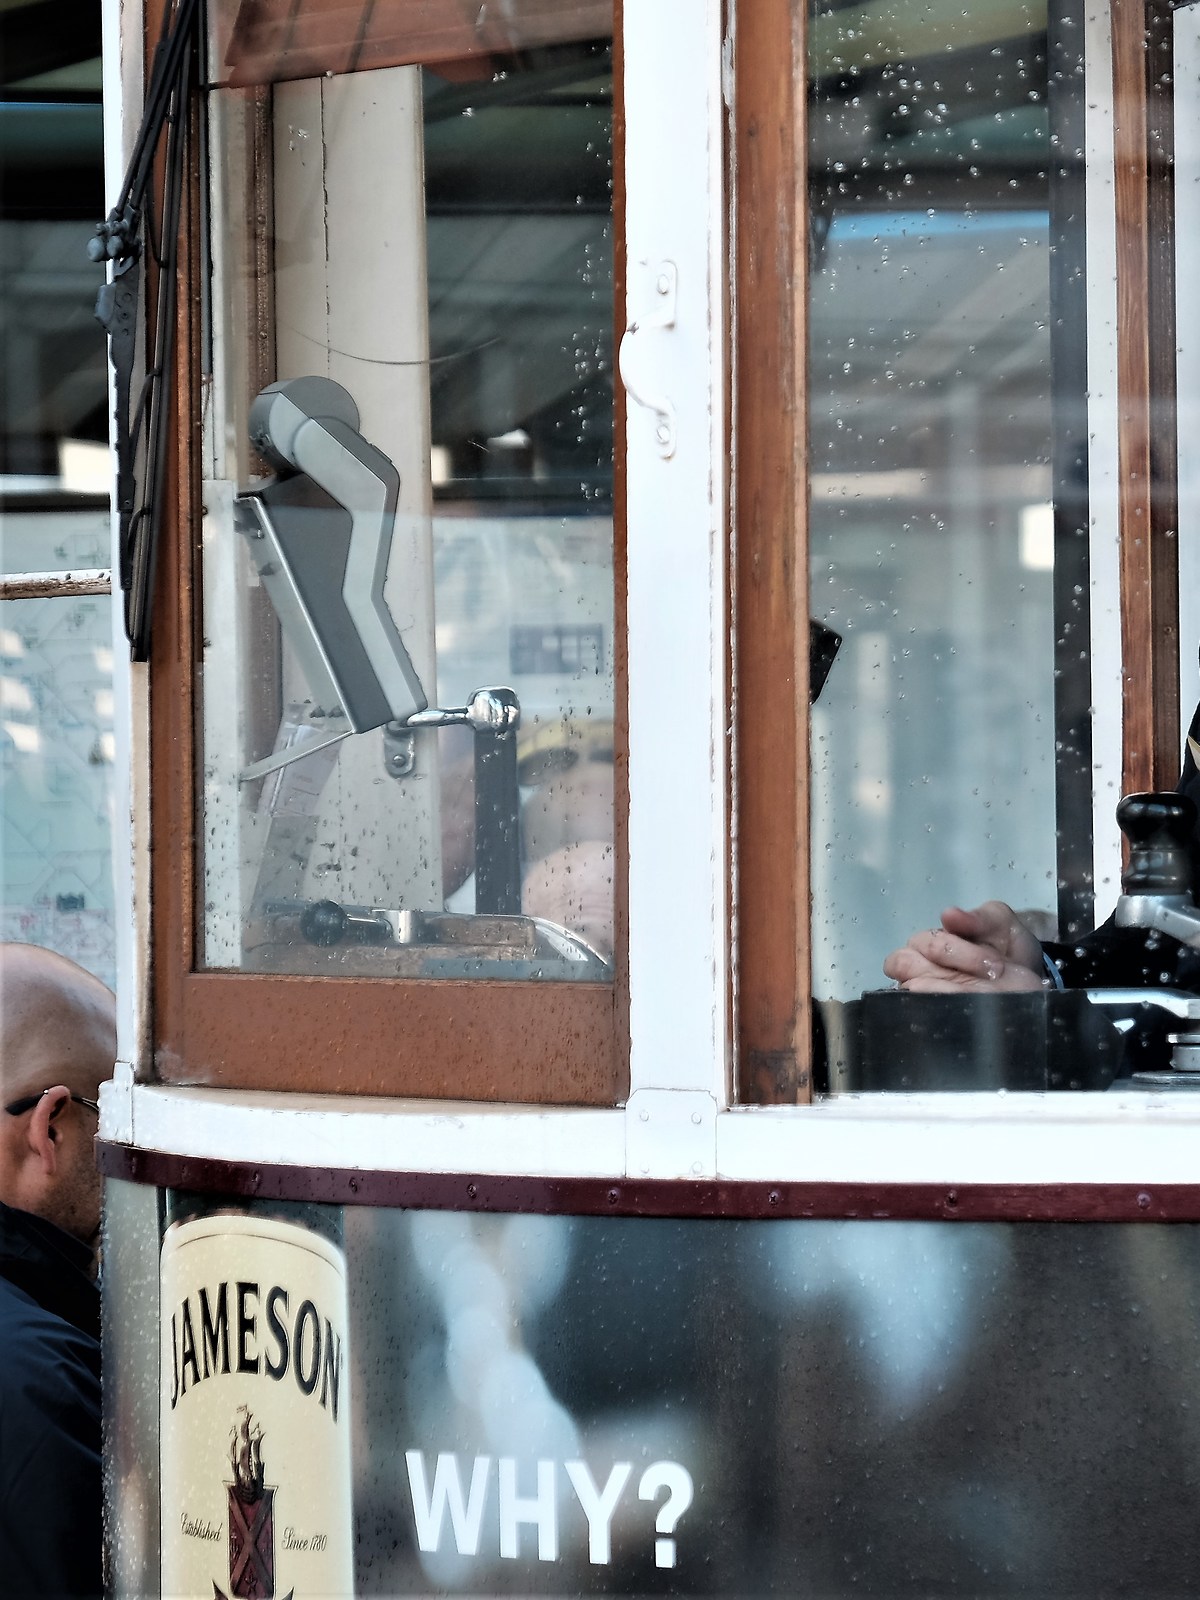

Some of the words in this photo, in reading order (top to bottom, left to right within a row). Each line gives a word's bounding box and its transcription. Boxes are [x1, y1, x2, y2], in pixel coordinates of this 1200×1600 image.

[170, 1281, 341, 1424] JAMESON
[181, 1512, 223, 1542] Established
[282, 1527, 308, 1551] Since
[308, 1532, 328, 1553] 1780
[405, 1449, 694, 1569] WHY?
